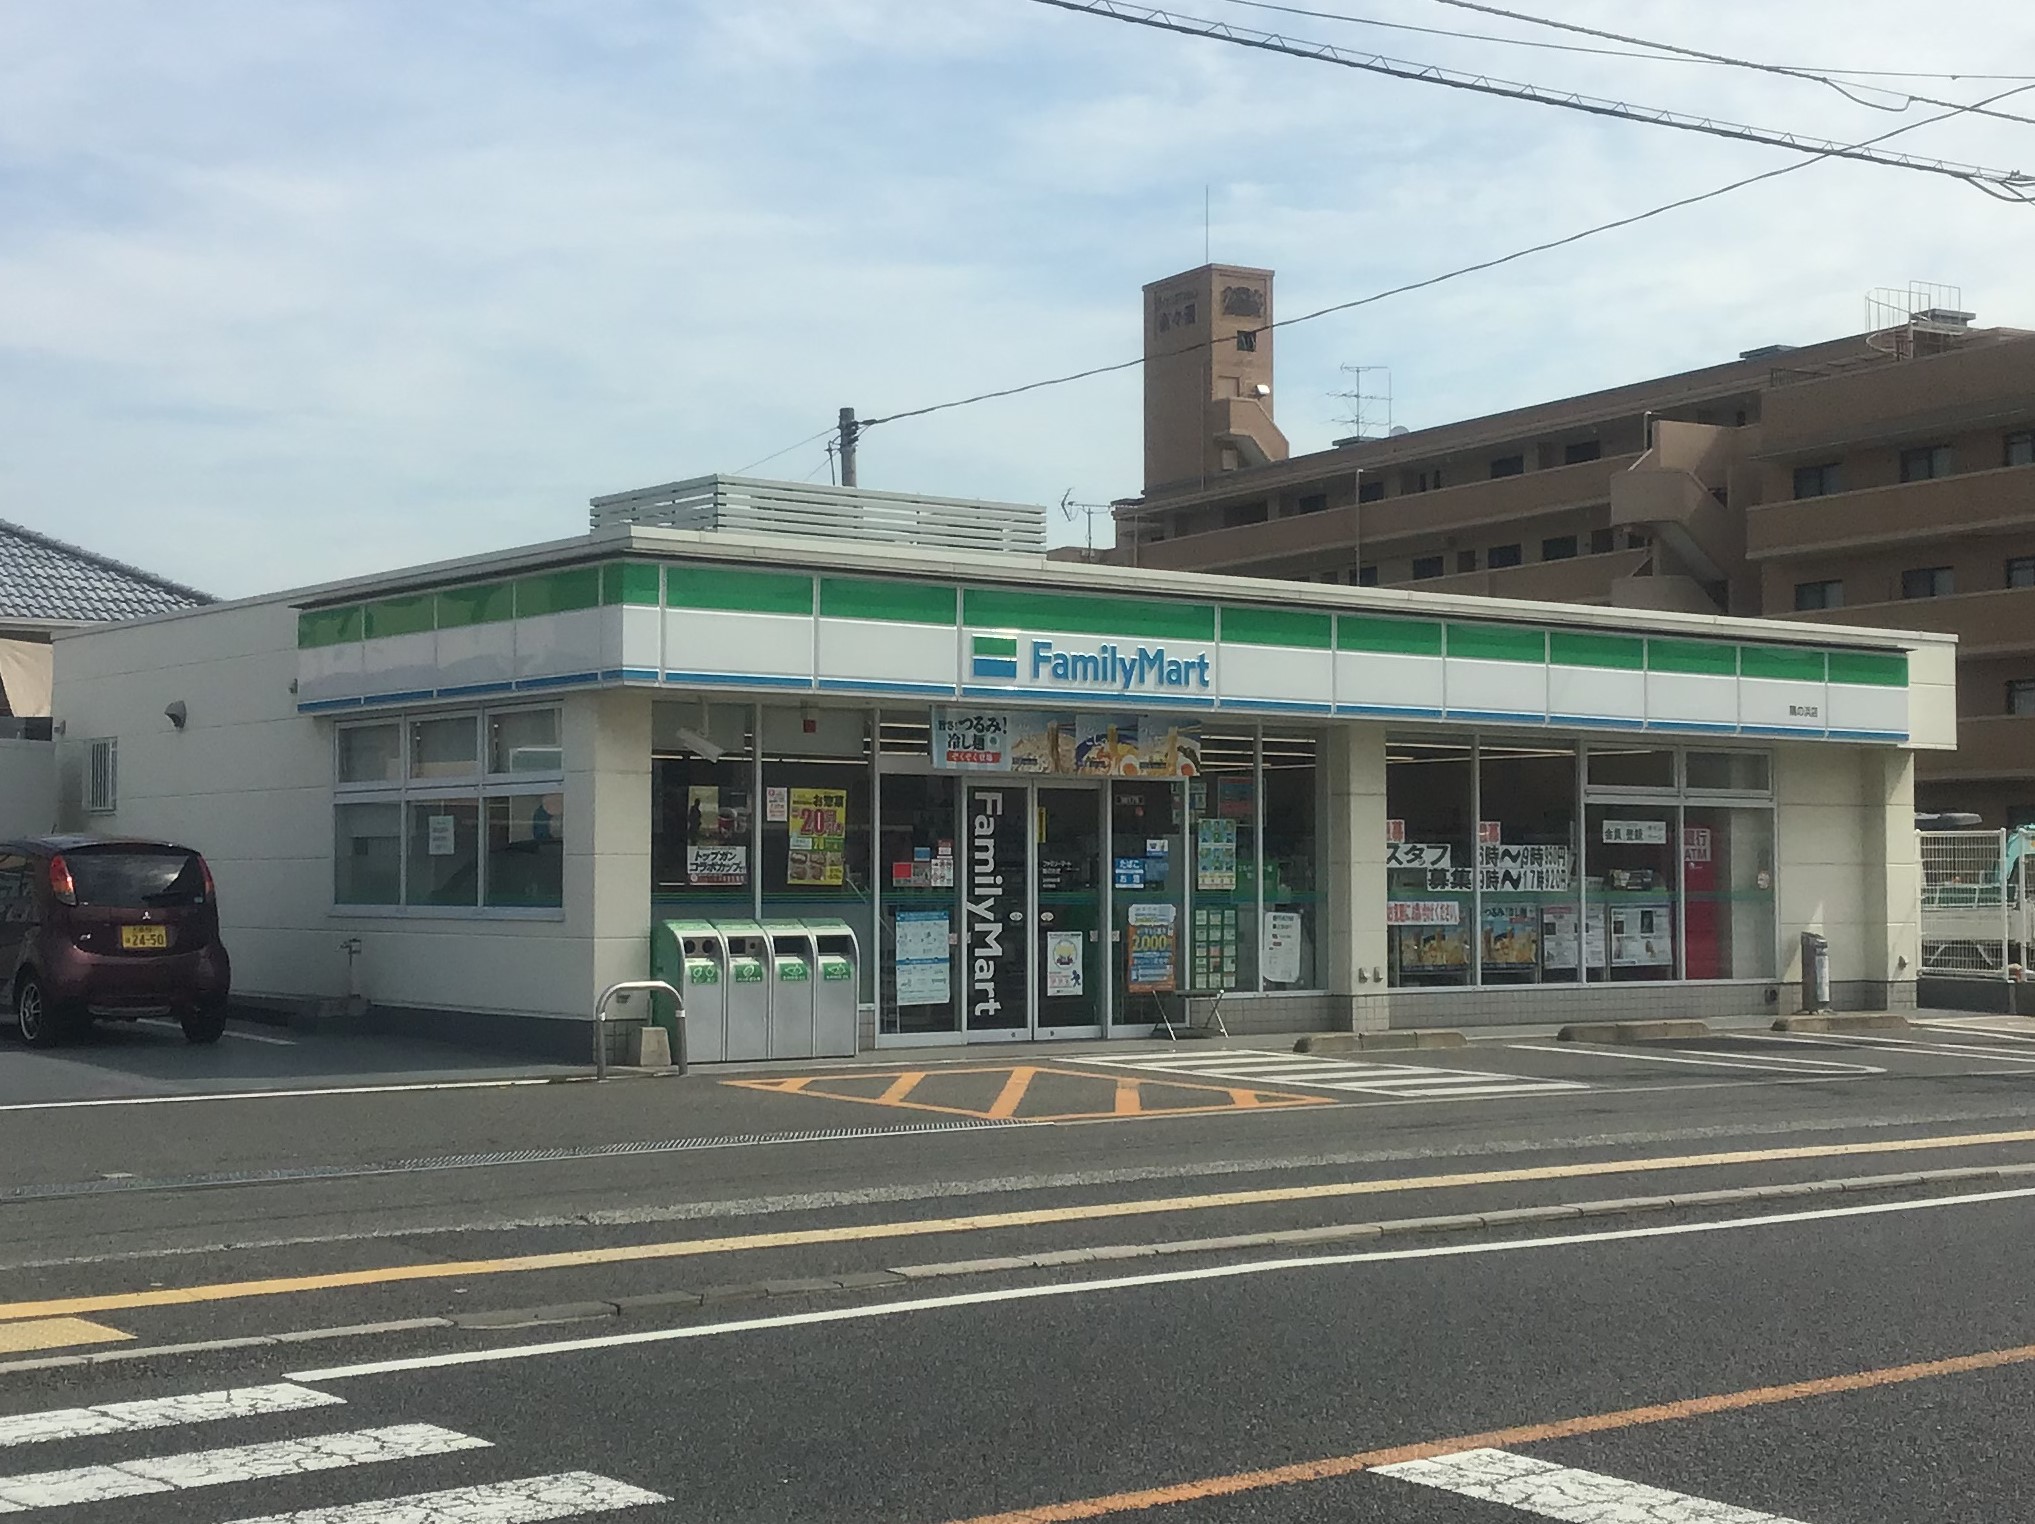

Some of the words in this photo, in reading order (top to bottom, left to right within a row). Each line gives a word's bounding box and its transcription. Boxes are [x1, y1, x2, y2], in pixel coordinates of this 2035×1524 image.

[1031, 639, 1210, 690] FamilyMart
[1386, 844, 1449, 866] スタッフ
[1427, 868, 1472, 890] 募集
[967, 791, 1003, 1016] FamilyMart
